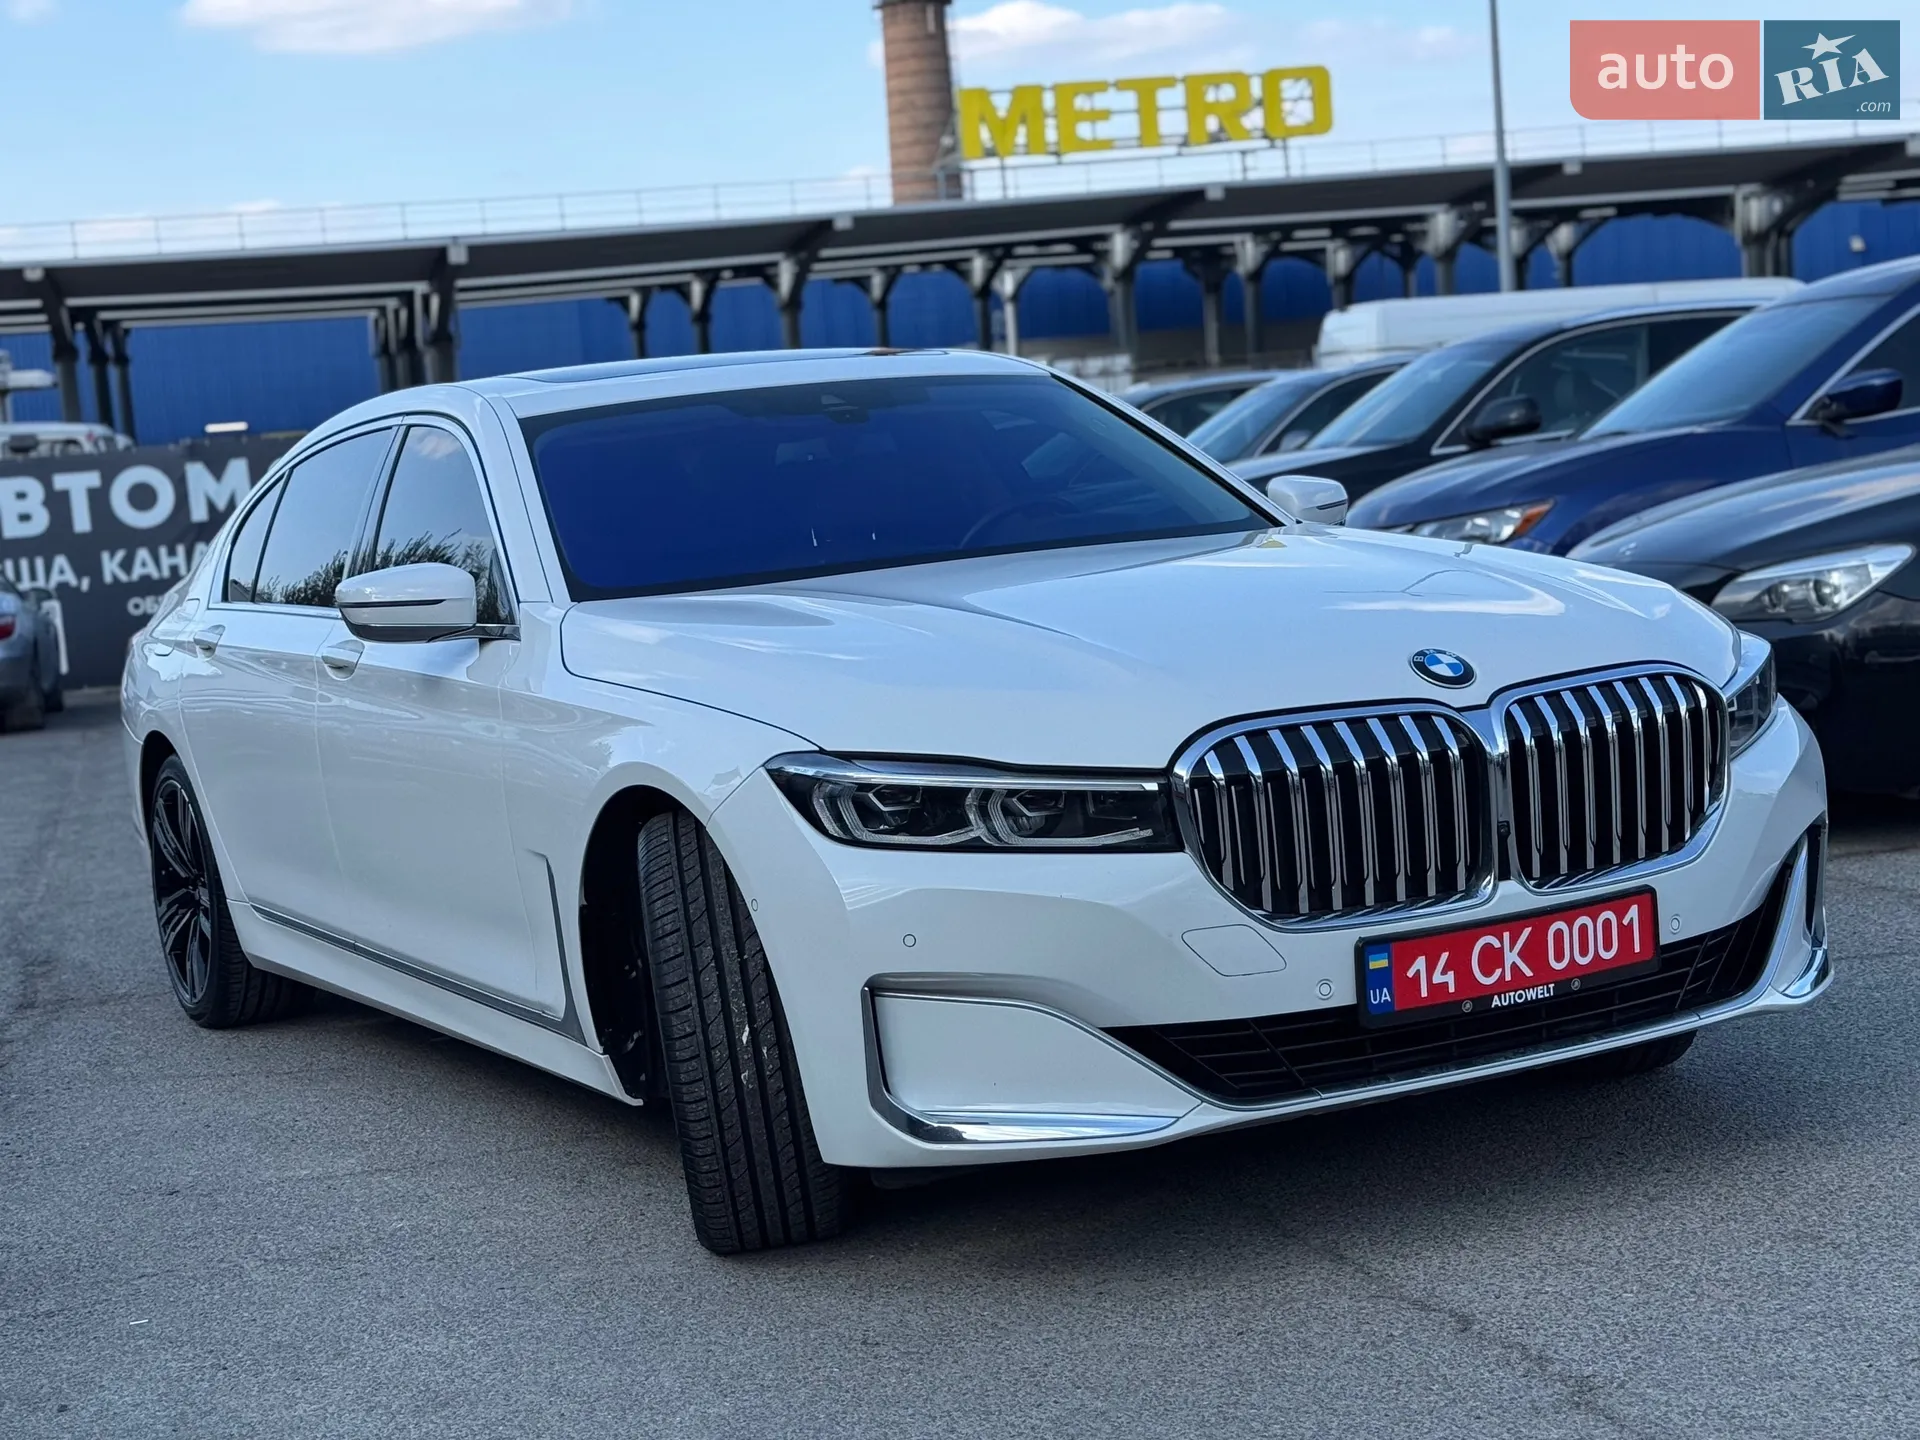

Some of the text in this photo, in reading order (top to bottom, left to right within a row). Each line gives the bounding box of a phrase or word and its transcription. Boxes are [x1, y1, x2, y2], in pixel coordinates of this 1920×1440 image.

[958, 65, 1333, 160] METRO
[0, 553, 91, 593] ША,
[1369, 904, 1640, 1004] UA 14 CK 0001
[1491, 983, 1555, 1008] AUTOWELT
